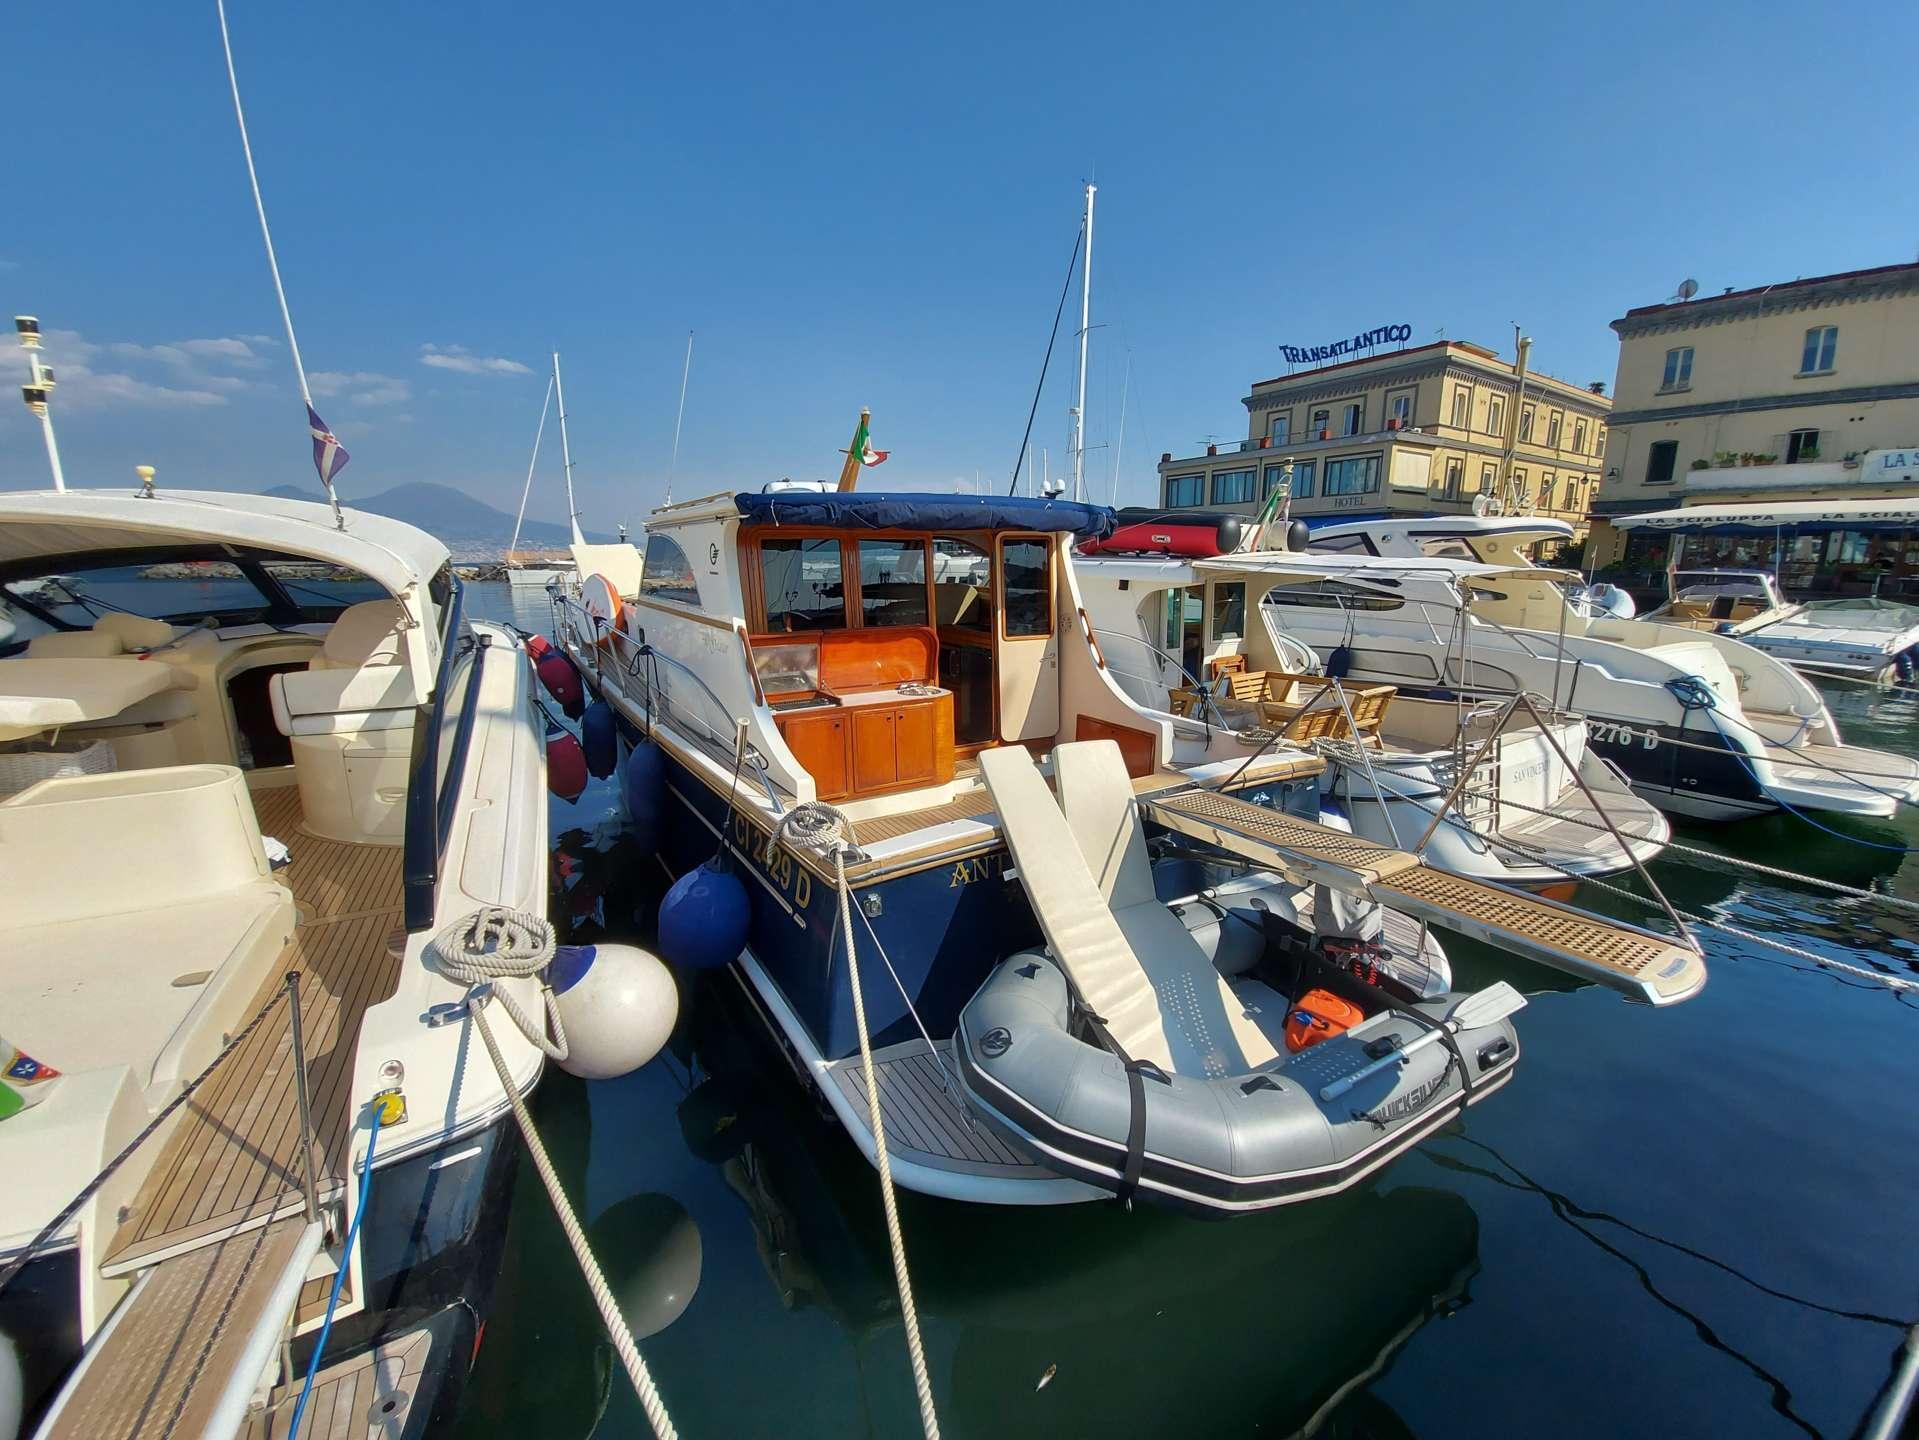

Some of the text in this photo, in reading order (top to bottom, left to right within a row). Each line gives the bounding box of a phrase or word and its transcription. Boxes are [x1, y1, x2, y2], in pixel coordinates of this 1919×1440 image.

[1279, 324, 1411, 363] TRANSATLANTICO
[1883, 453, 1906, 468] LA
[1334, 496, 1367, 508] HOTEL
[1677, 514, 1775, 523] SCIALUPPA
[1643, 728, 1659, 750] D
[795, 866, 811, 909] D
